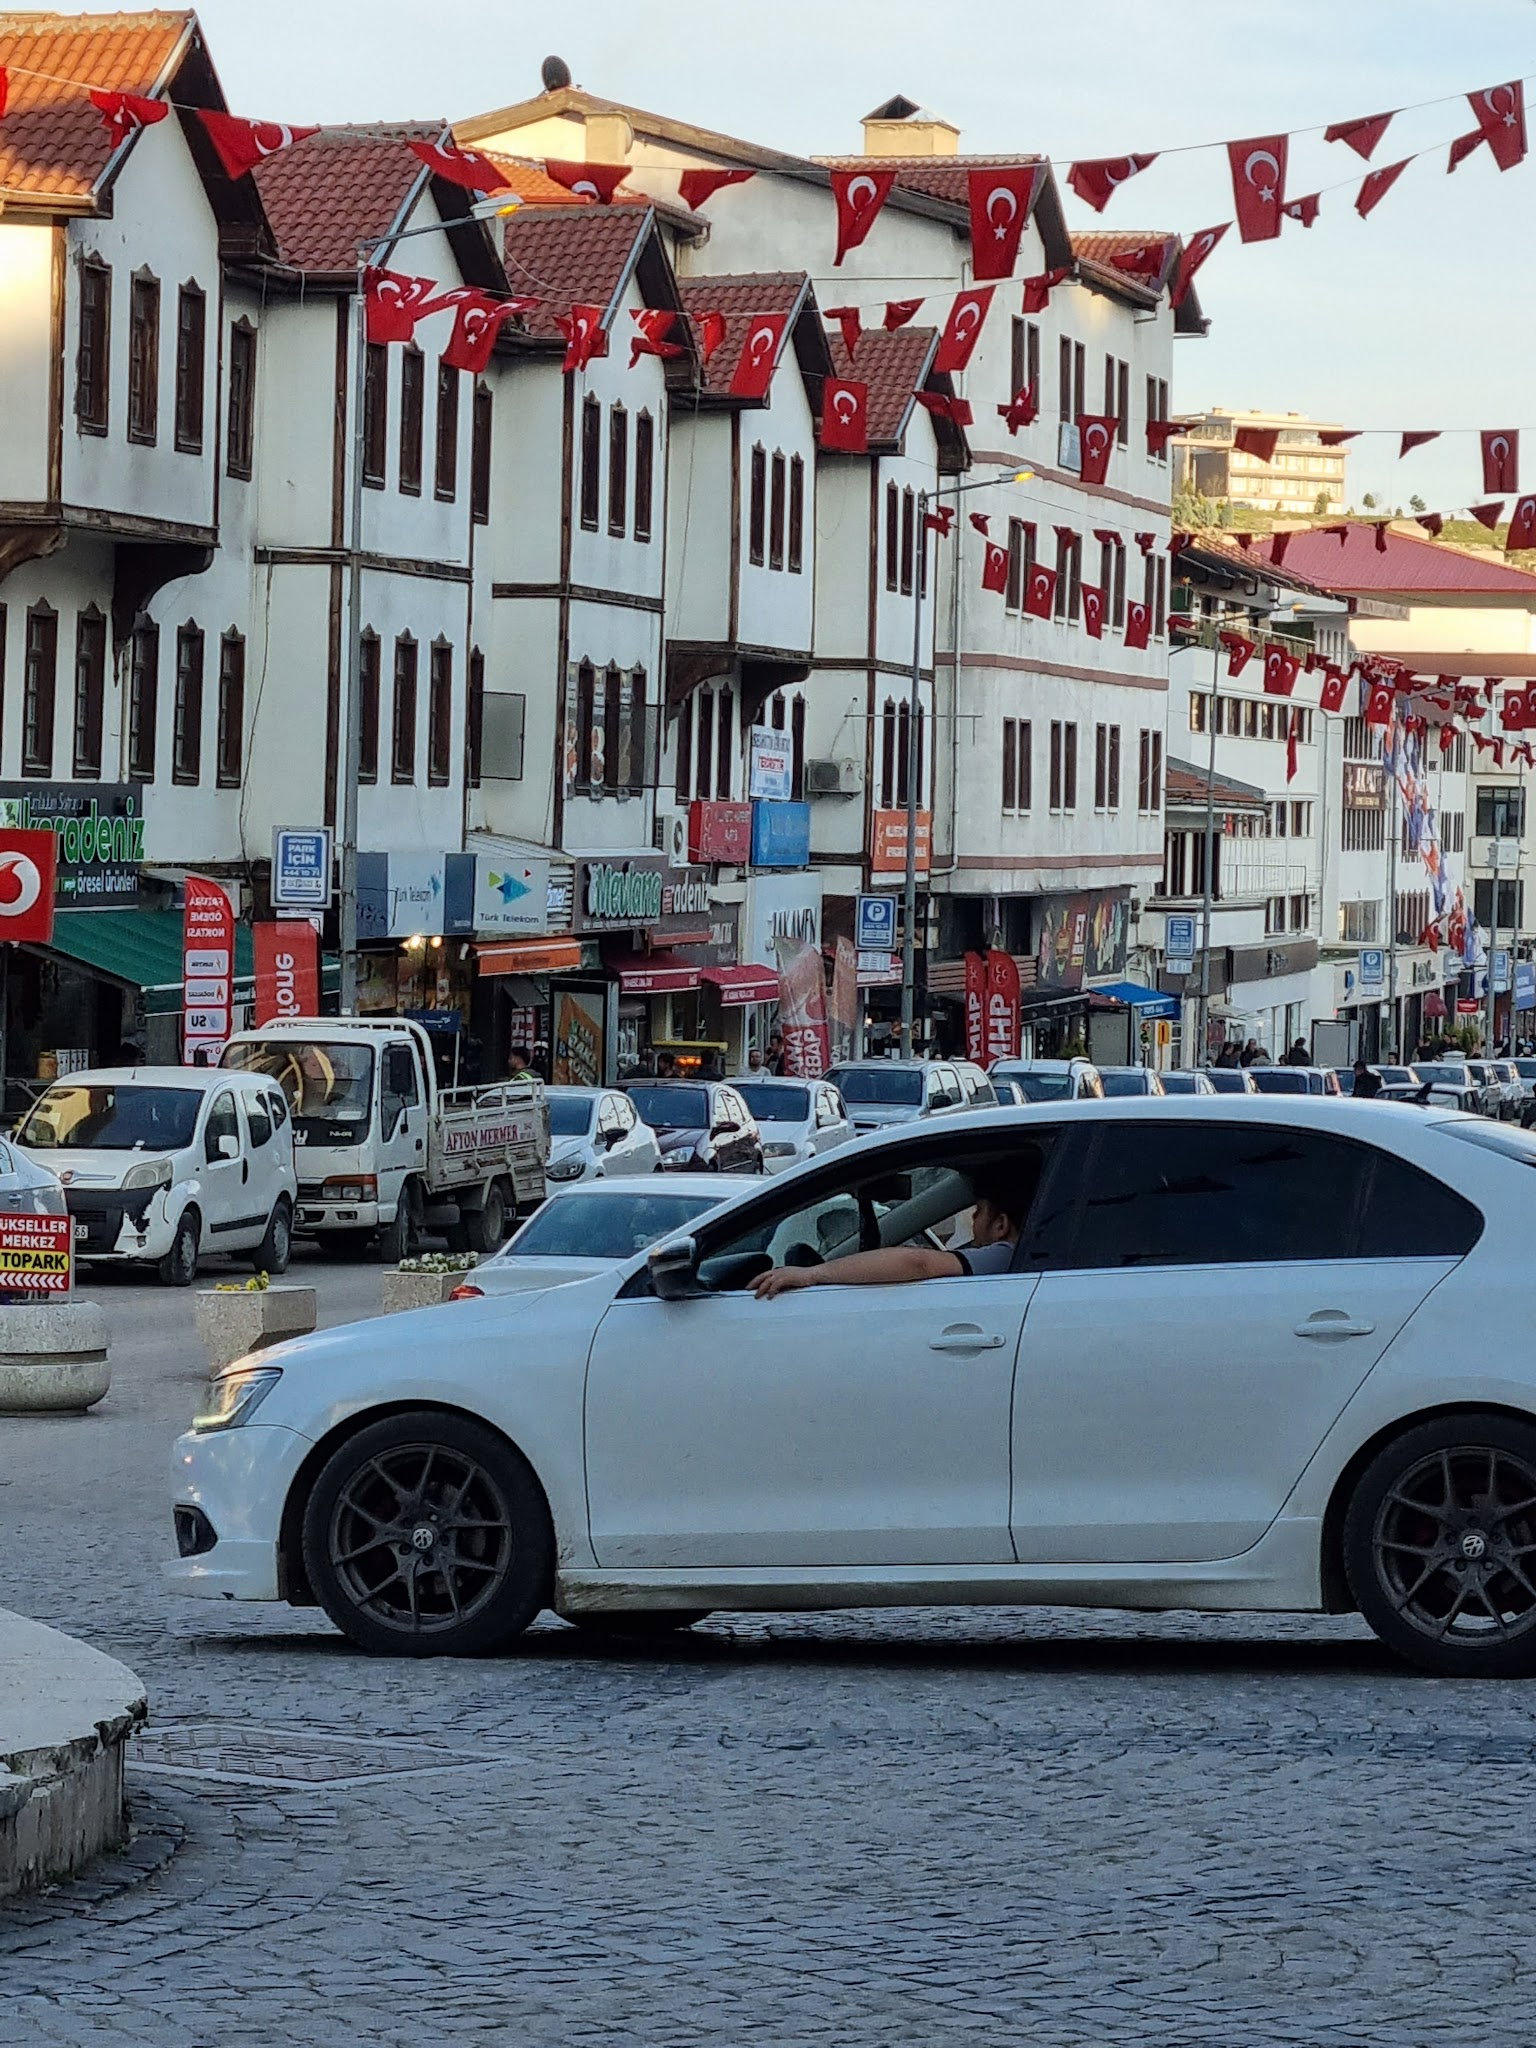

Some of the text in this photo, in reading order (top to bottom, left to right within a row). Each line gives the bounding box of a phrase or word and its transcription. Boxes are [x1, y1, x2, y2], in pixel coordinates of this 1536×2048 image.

[287, 845, 316, 853] PARK
[287, 852, 316, 866] İÇİN
[480, 912, 540, 924] Türk Telekom
[968, 991, 982, 1060] MHP
[2, 1234, 56, 1249] MERKEZ
[0, 1252, 66, 1270] TOPARK
